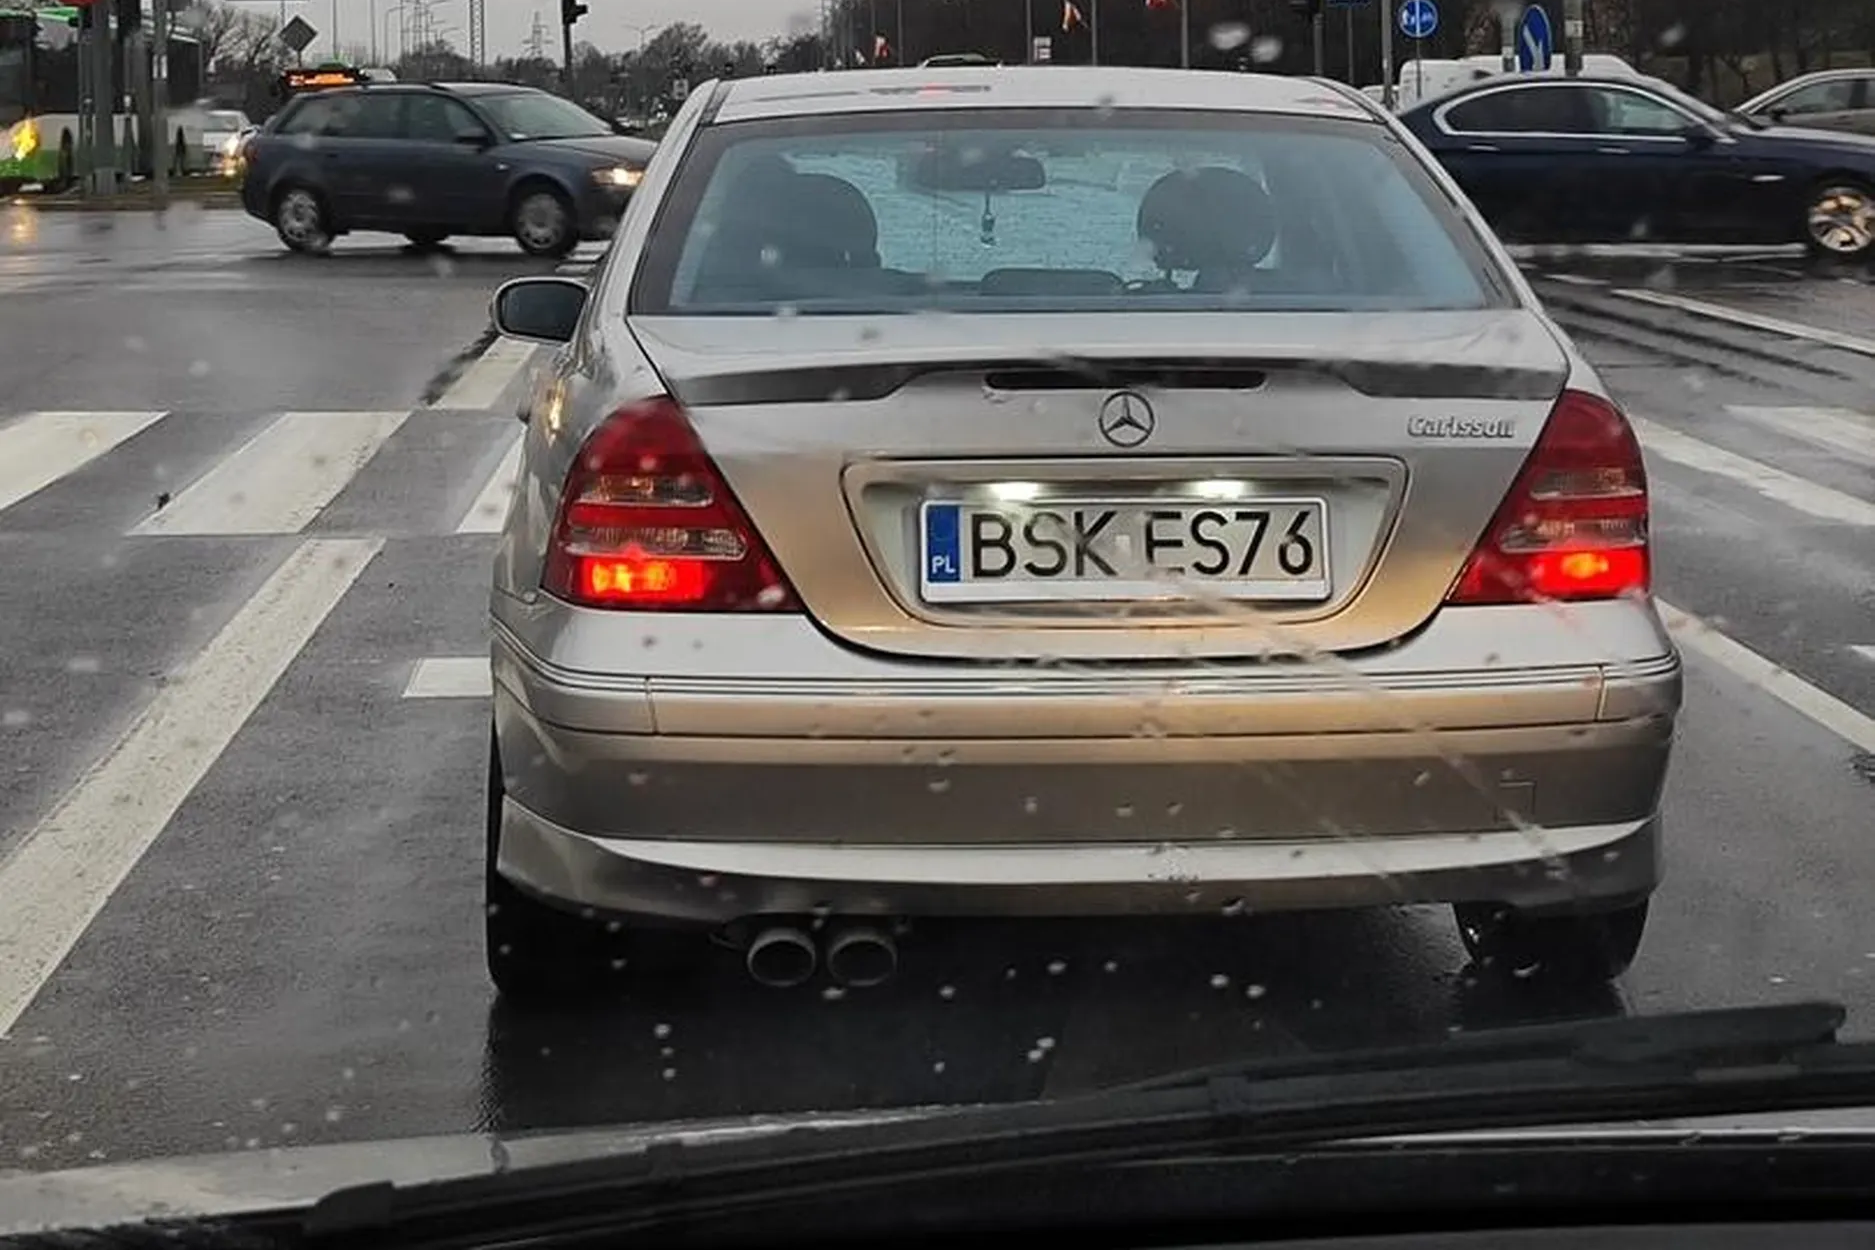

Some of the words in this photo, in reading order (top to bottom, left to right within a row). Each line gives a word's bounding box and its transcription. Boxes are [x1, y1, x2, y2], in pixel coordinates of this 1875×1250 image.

[932, 555, 956, 574] PL
[971, 511, 1117, 578] BSK
[1144, 510, 1314, 577] ES76
